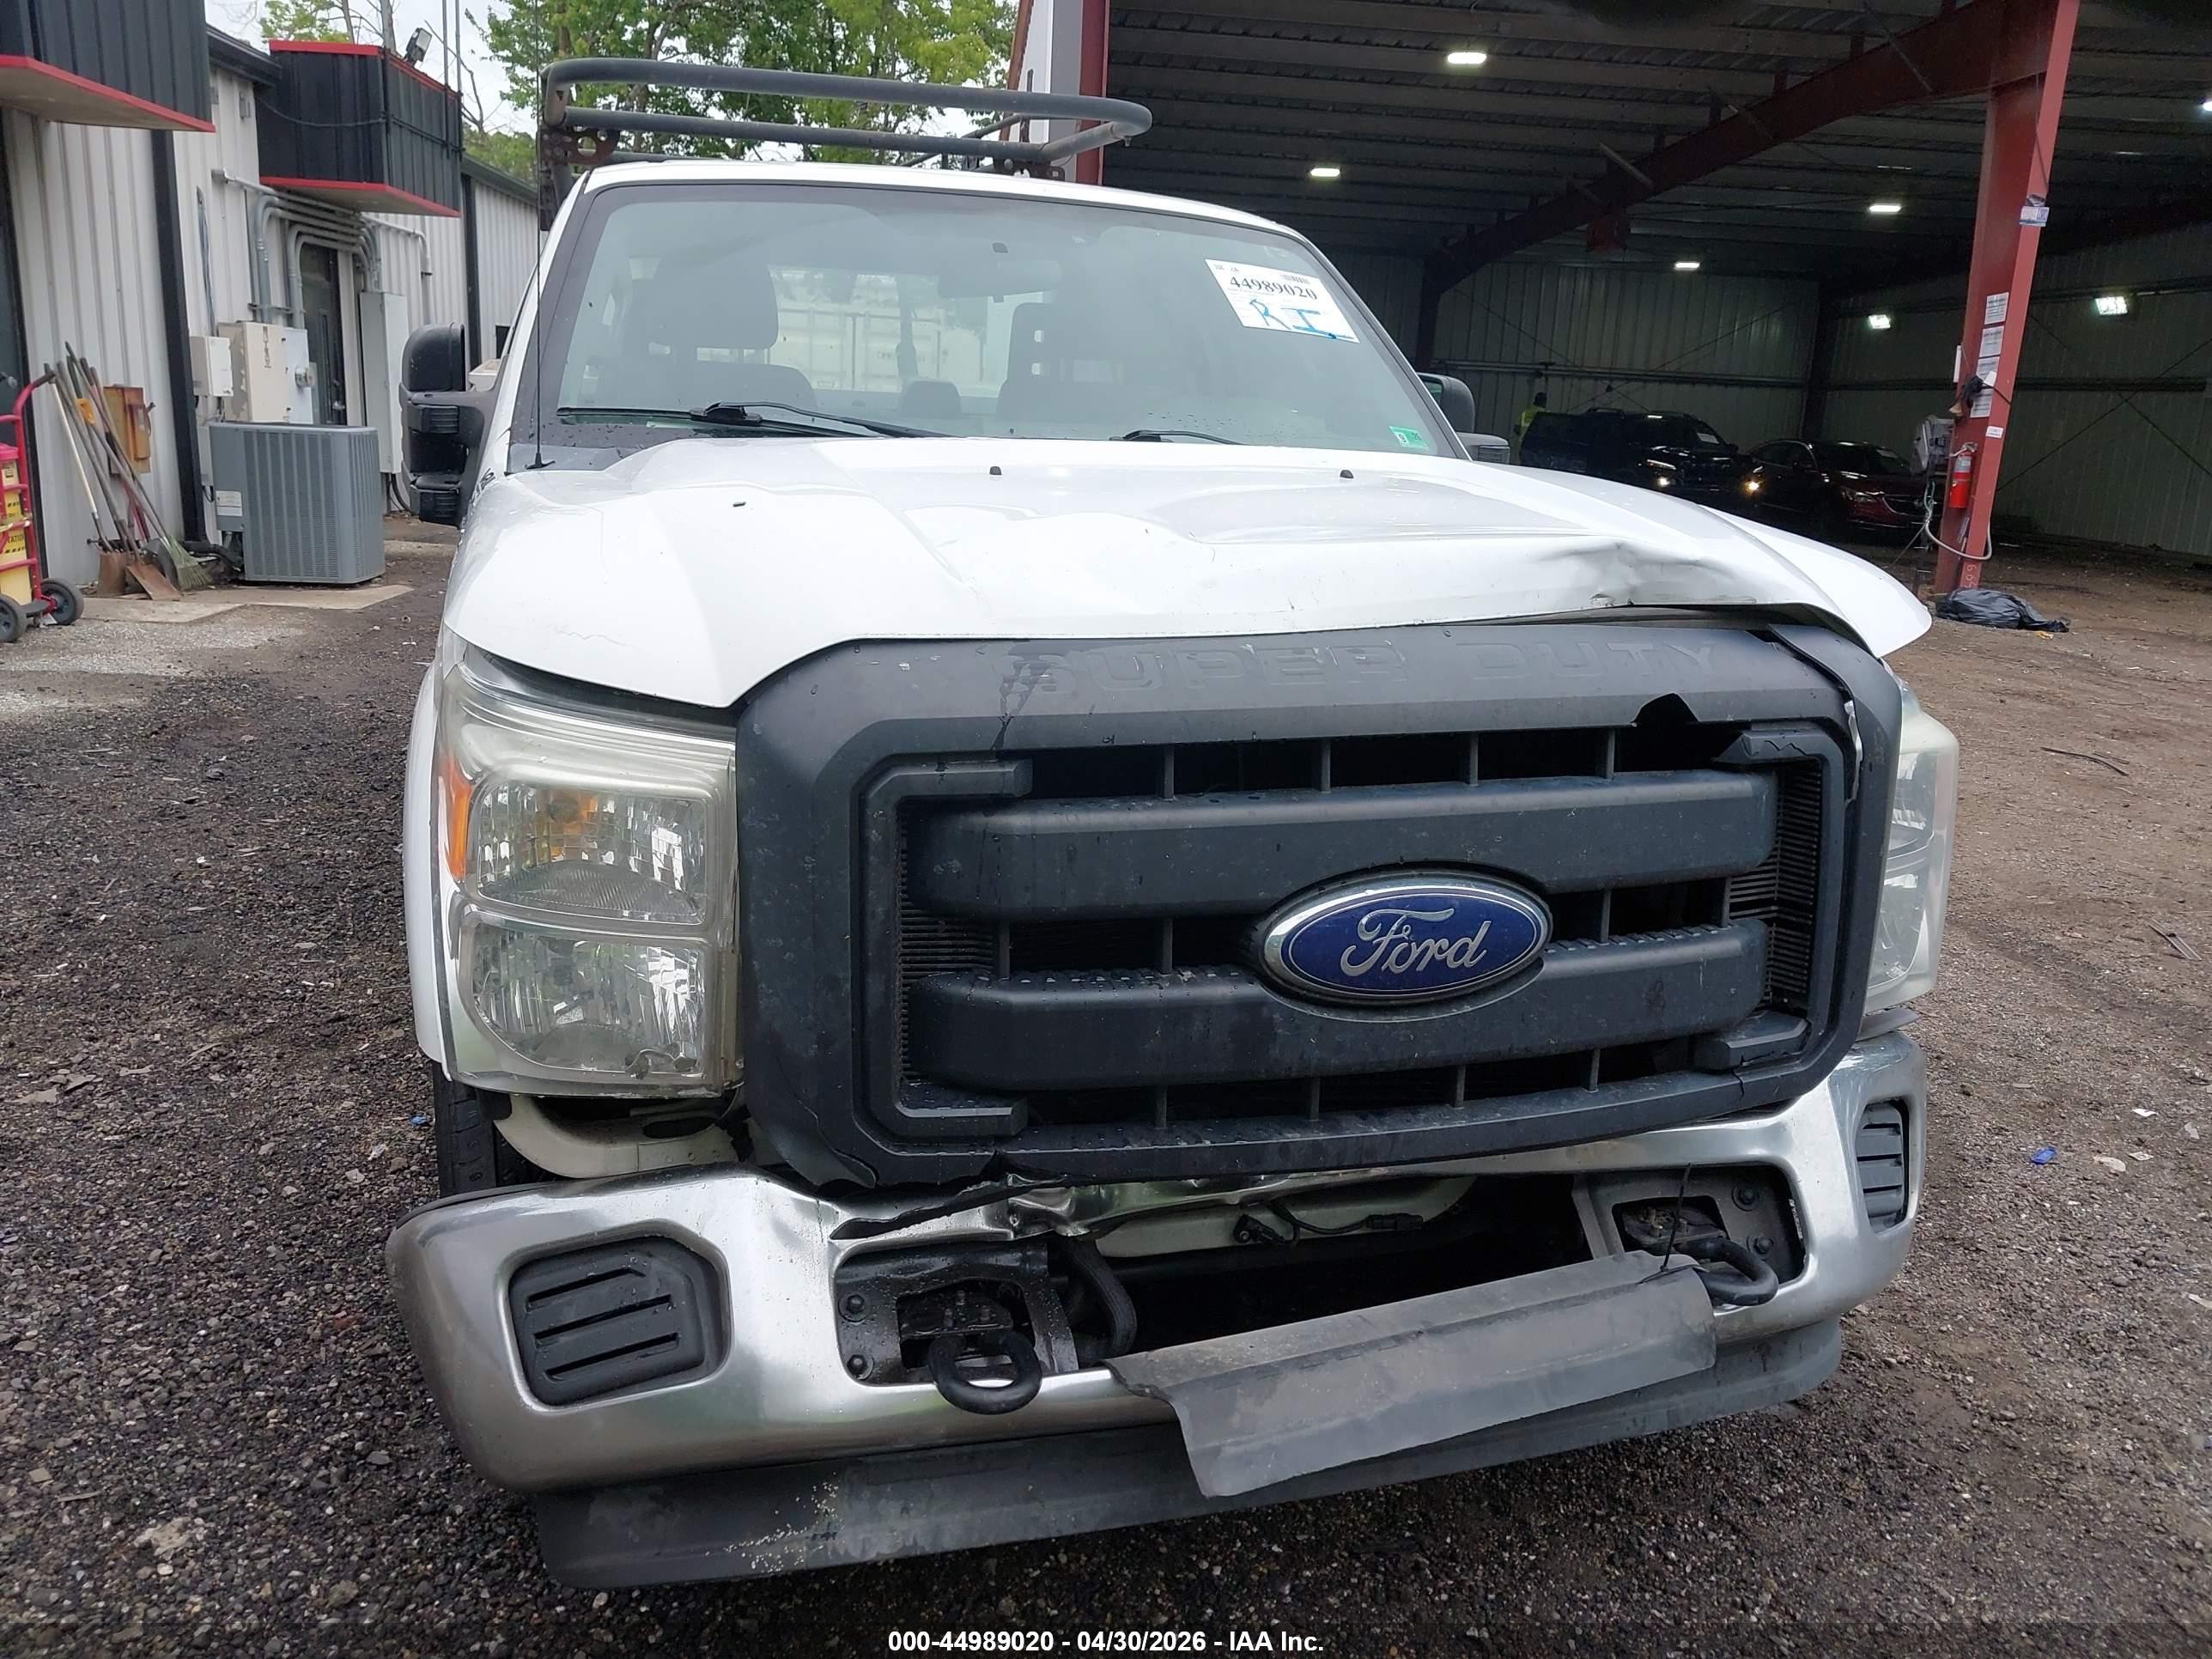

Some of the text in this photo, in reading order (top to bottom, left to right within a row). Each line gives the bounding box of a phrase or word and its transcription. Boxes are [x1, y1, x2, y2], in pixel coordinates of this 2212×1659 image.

[1230, 276, 1318, 301] 44989020
[994, 641, 1717, 693] SUPER DUTY
[1340, 908, 1492, 977] Ford
